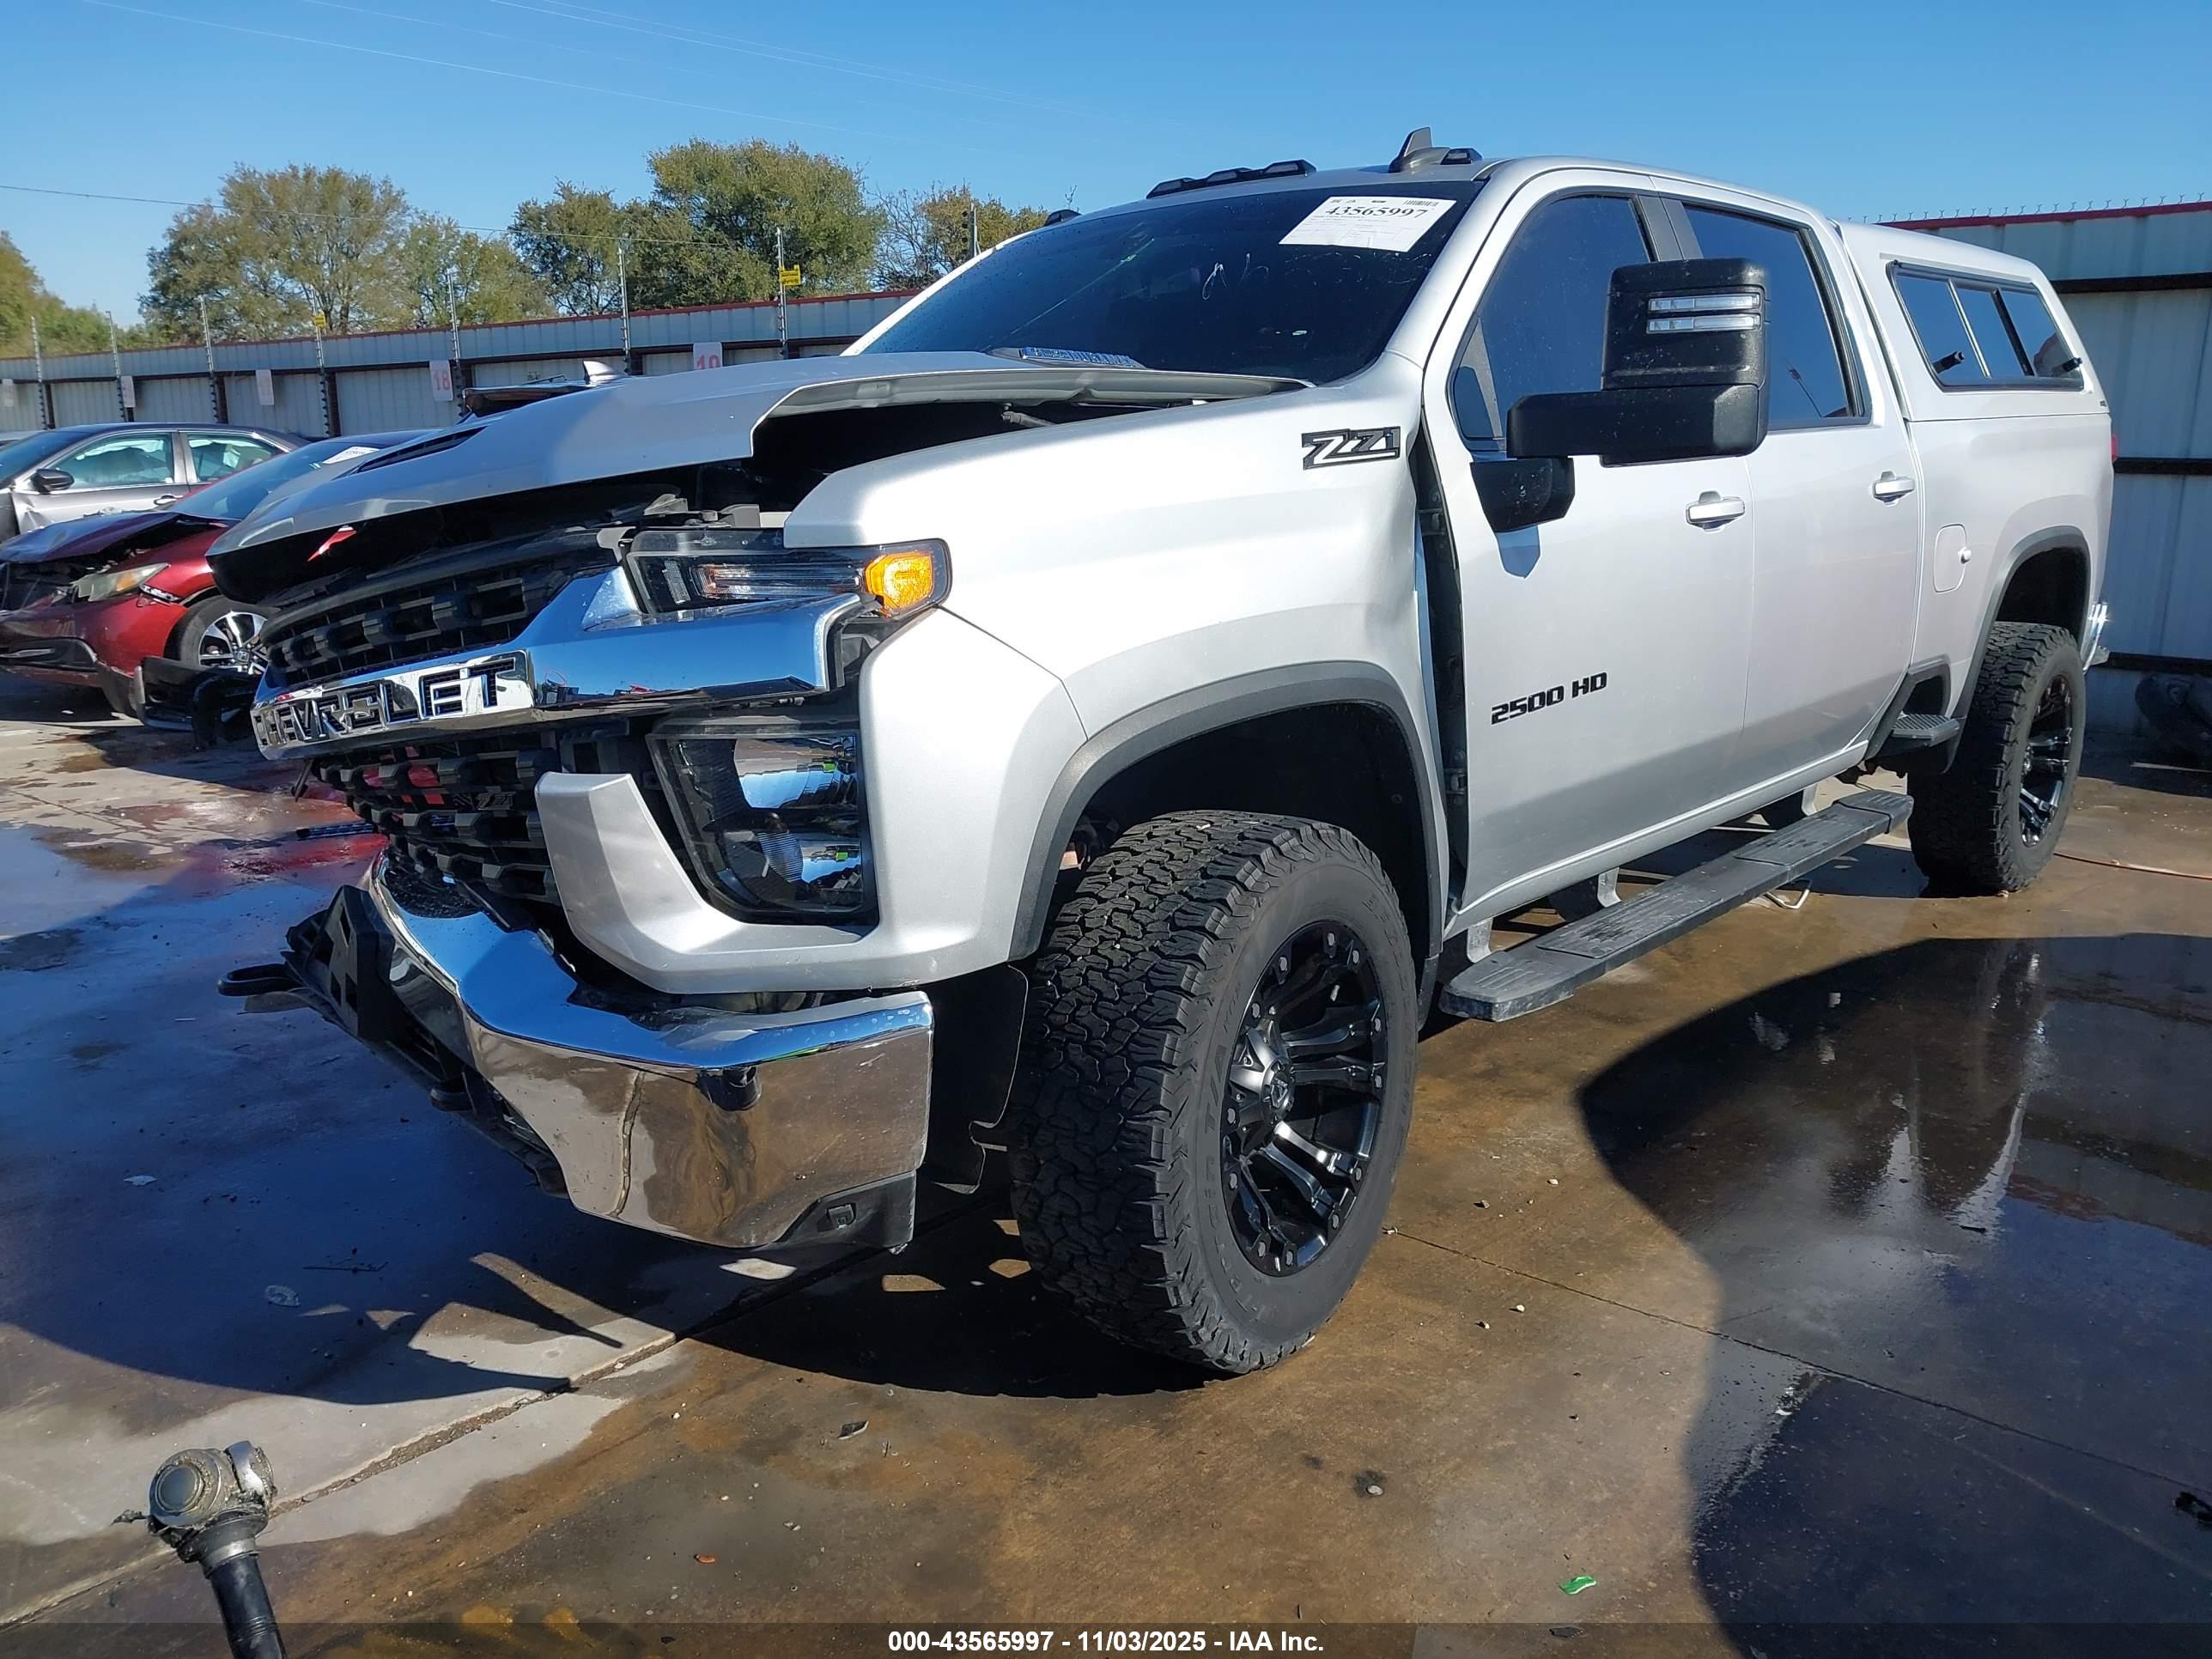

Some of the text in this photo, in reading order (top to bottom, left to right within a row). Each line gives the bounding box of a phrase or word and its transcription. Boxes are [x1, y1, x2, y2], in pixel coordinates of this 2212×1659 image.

[1325, 206, 1430, 218] 43565997
[433, 370, 451, 391] 18
[1492, 672, 1607, 725] 2500 HD
